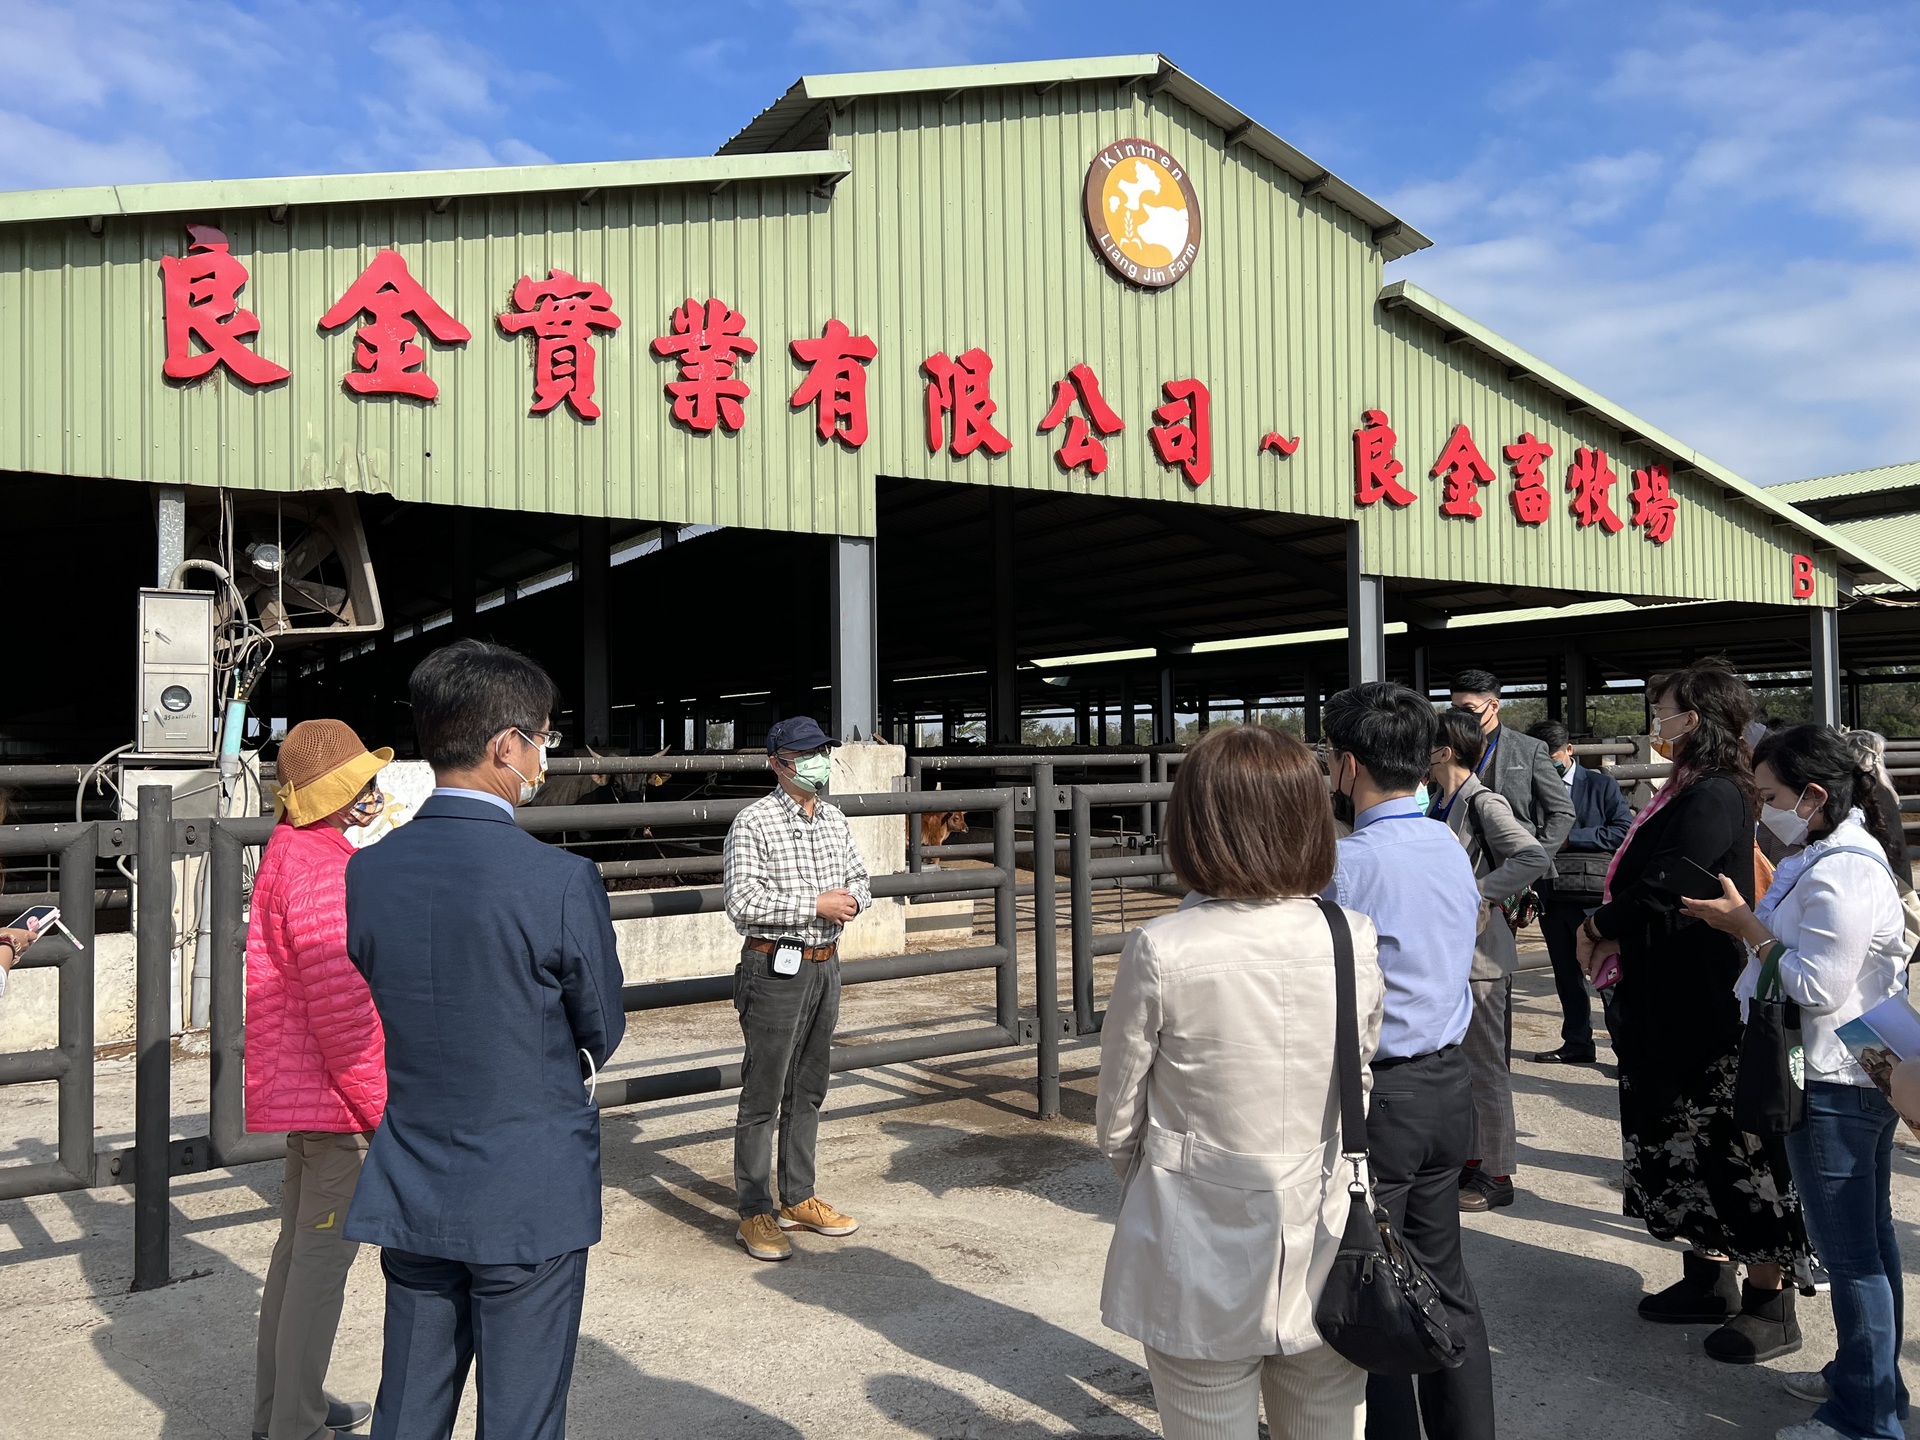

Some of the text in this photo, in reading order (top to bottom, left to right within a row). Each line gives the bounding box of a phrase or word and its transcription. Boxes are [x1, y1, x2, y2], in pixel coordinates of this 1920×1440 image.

[1100, 143, 1183, 181] Kinmen
[1100, 233, 1196, 282] Liang Jin Farm
[1793, 553, 1815, 598] B
